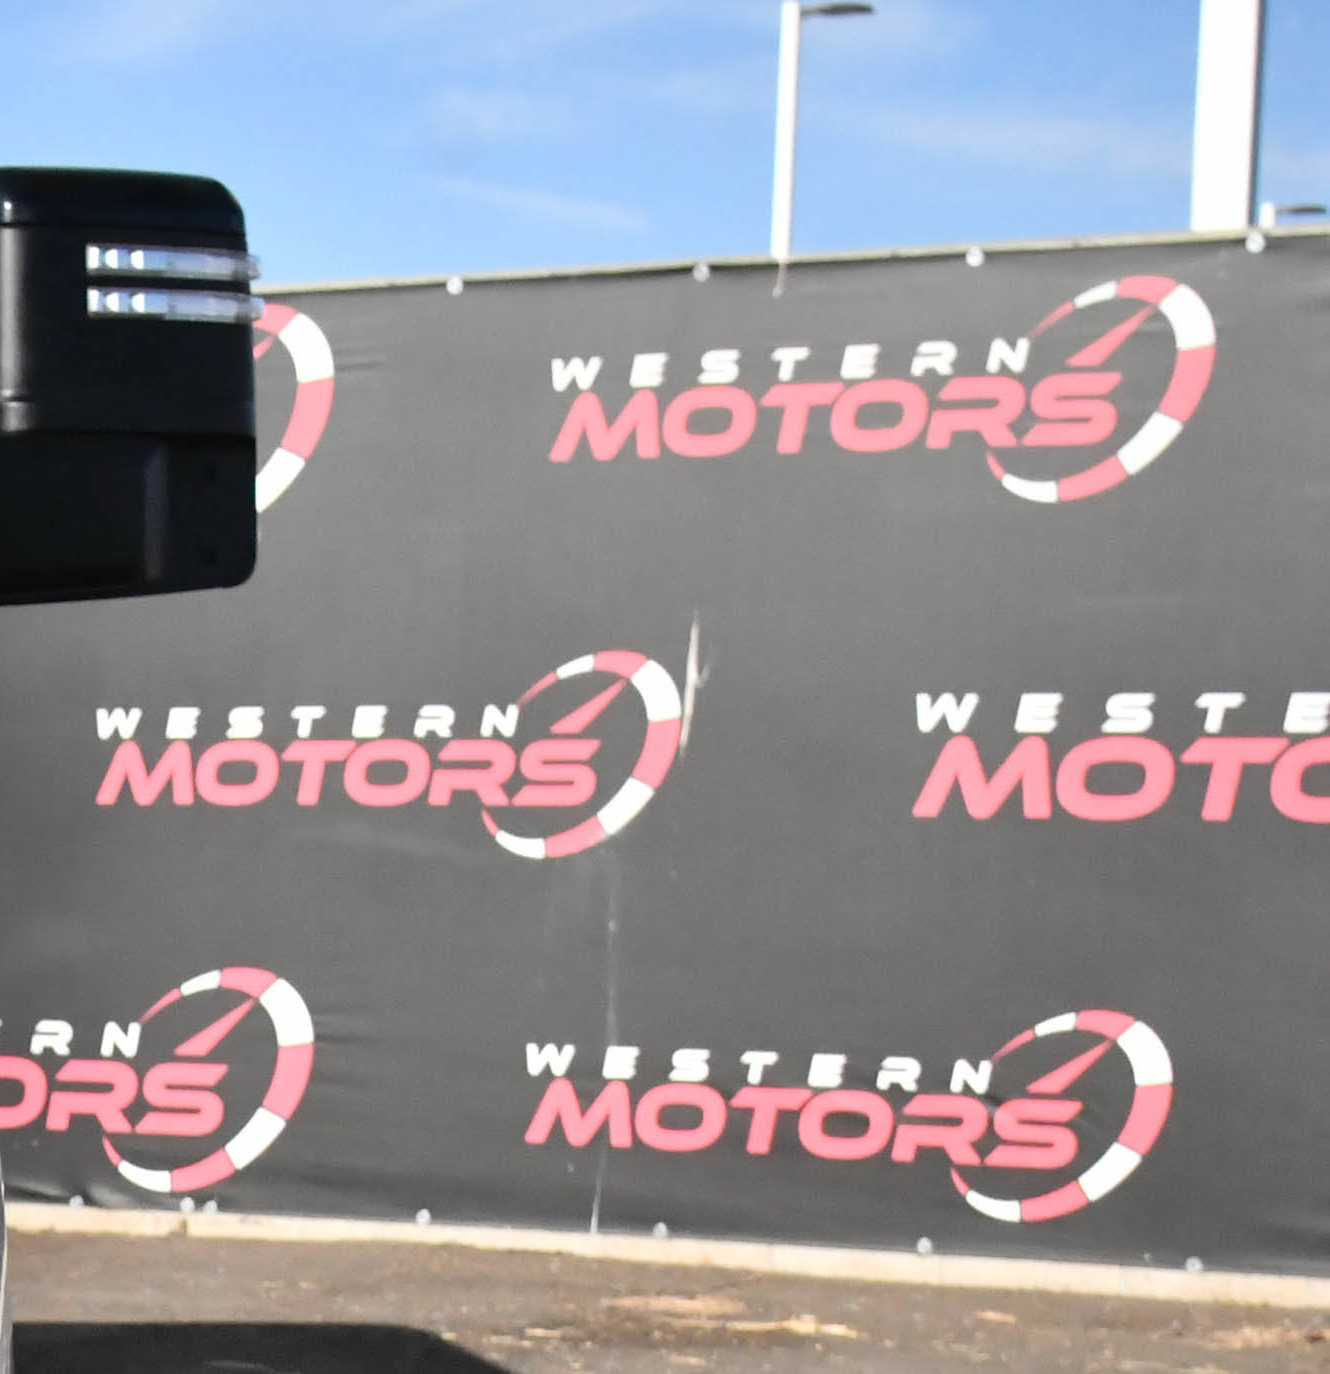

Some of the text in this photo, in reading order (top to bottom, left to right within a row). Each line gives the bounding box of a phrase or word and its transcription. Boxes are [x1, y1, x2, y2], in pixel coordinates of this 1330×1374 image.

[549, 335, 1032, 394] WESTERN
[548, 370, 1123, 464] MOTORS
[94, 702, 520, 741] WESTERN
[94, 736, 602, 808] MOTORS
[524, 1041, 994, 1096] WESTERN
[523, 1076, 1084, 1171] MOTORS
